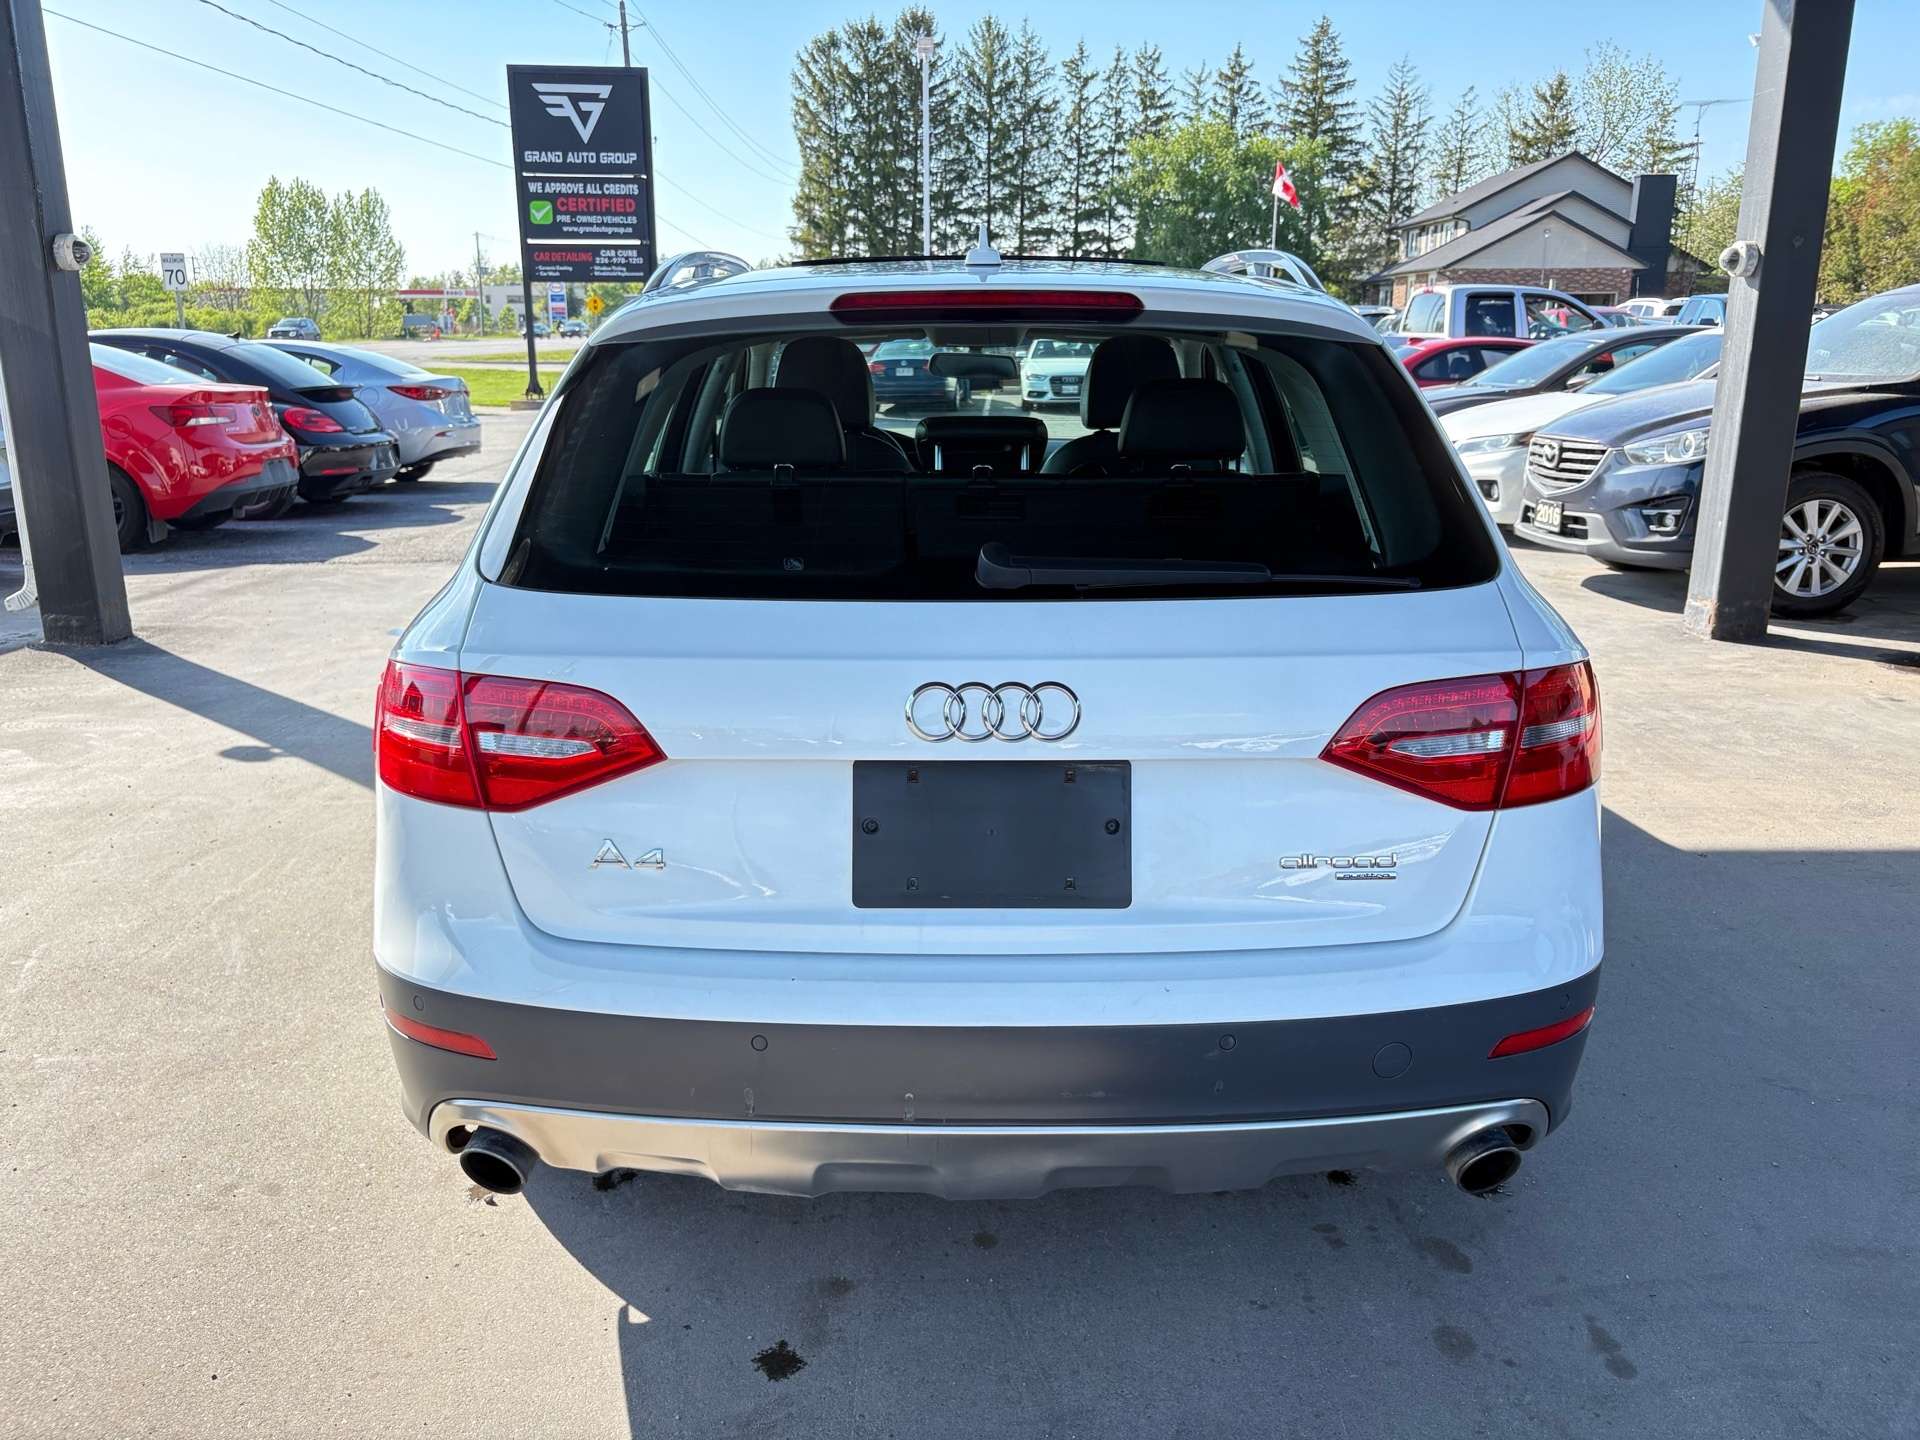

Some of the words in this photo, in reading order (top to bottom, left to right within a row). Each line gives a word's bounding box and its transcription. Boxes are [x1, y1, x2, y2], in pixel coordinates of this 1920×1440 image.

[524, 151, 562, 163] GRAND
[567, 152, 596, 164] AUTO
[600, 152, 638, 164] GROUP
[528, 182, 542, 193] WE
[544, 182, 583, 194] APPROVE
[586, 183, 602, 195] ALL
[603, 183, 639, 195] CREDITS
[556, 197, 636, 213] CERTIFIED
[556, 215, 571, 223] PRE
[576, 215, 602, 224] OWNED
[603, 216, 638, 224] VEHICLES
[533, 252, 550, 262] CAR
[551, 252, 593, 263] DETAILING
[164, 269, 185, 285] 70
[1536, 503, 1560, 526] 2016
[592, 838, 665, 870] A4
[1280, 852, 1398, 869] allroad
